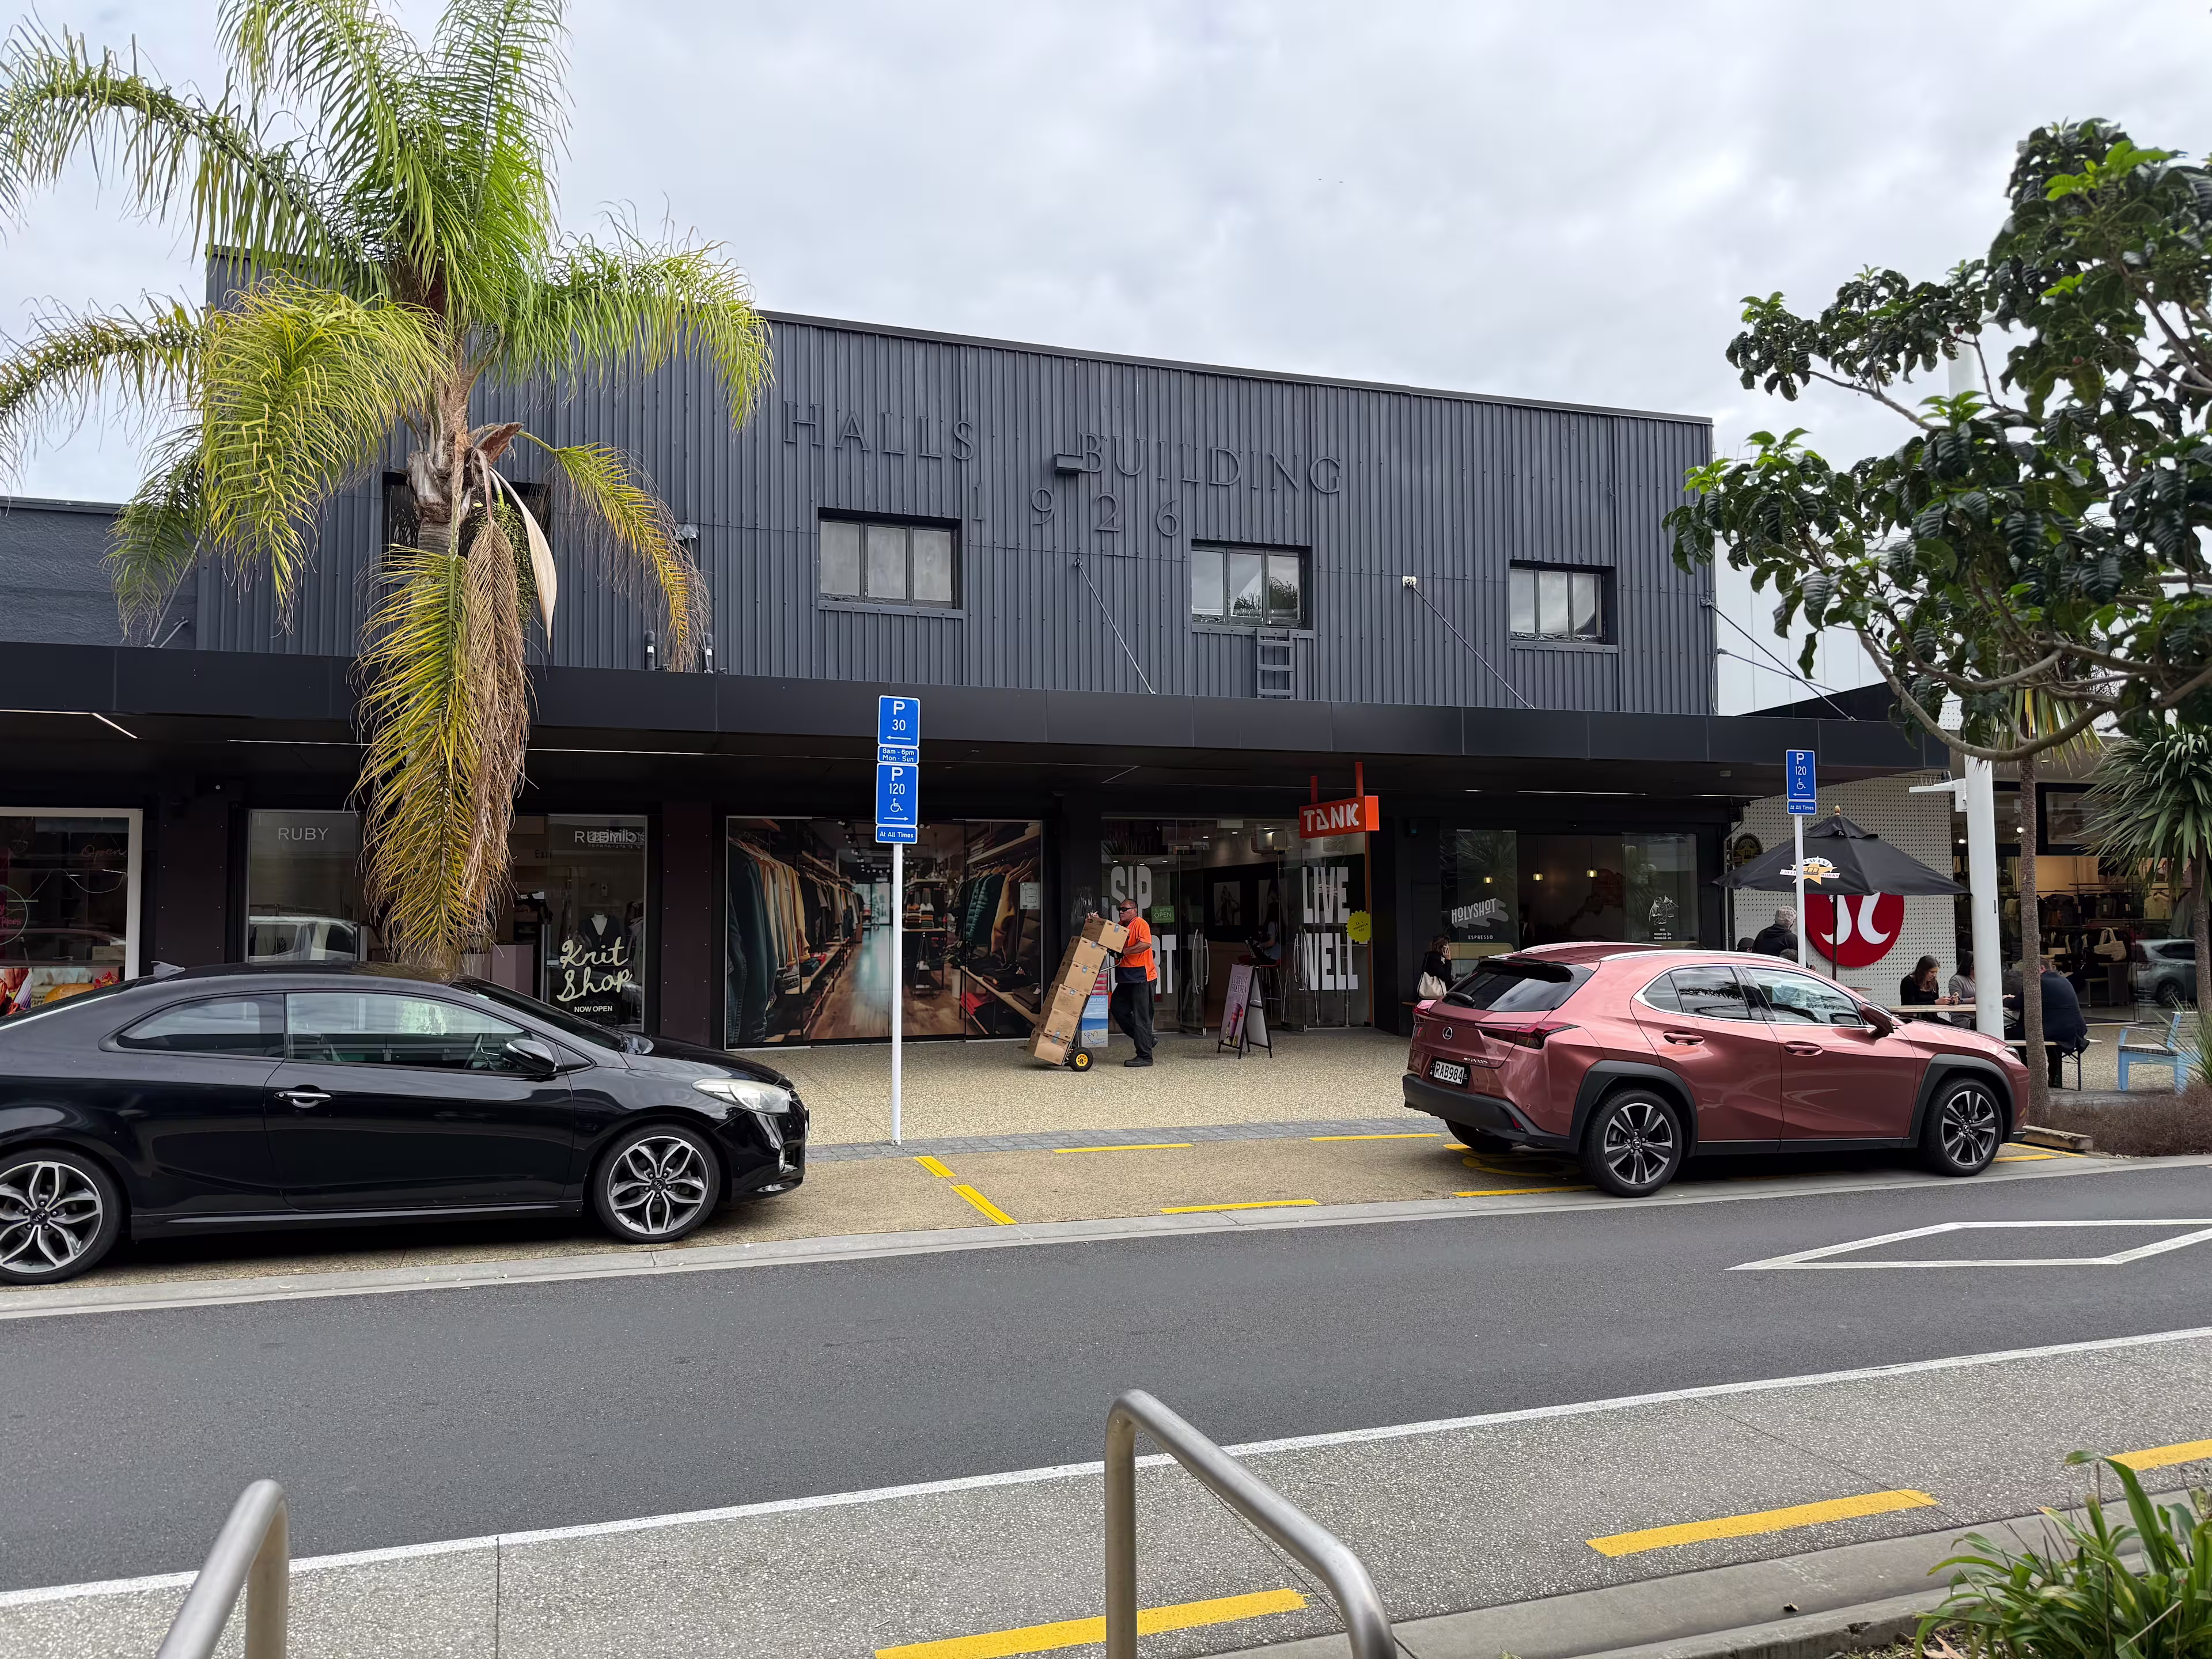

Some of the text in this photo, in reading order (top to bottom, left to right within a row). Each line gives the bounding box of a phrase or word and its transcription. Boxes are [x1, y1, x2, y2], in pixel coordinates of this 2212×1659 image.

[784, 401, 1342, 494] HALLS BUILDING
[974, 482, 1181, 537] 1926
[893, 700, 906, 715] P
[892, 719, 906, 730] 30
[1796, 753, 1805, 764] P
[891, 767, 903, 781] P
[1796, 766, 1806, 775] 120
[889, 783, 905, 794] 120
[1304, 803, 1359, 832] TANK
[278, 828, 328, 840] RUBY
[1111, 866, 1350, 923] SIP LIVE
[1452, 898, 1497, 924] HOLYSHOT
[560, 936, 628, 969] Knit
[556, 966, 632, 1002] Shop
[1435, 1063, 1463, 1083] RAB984
